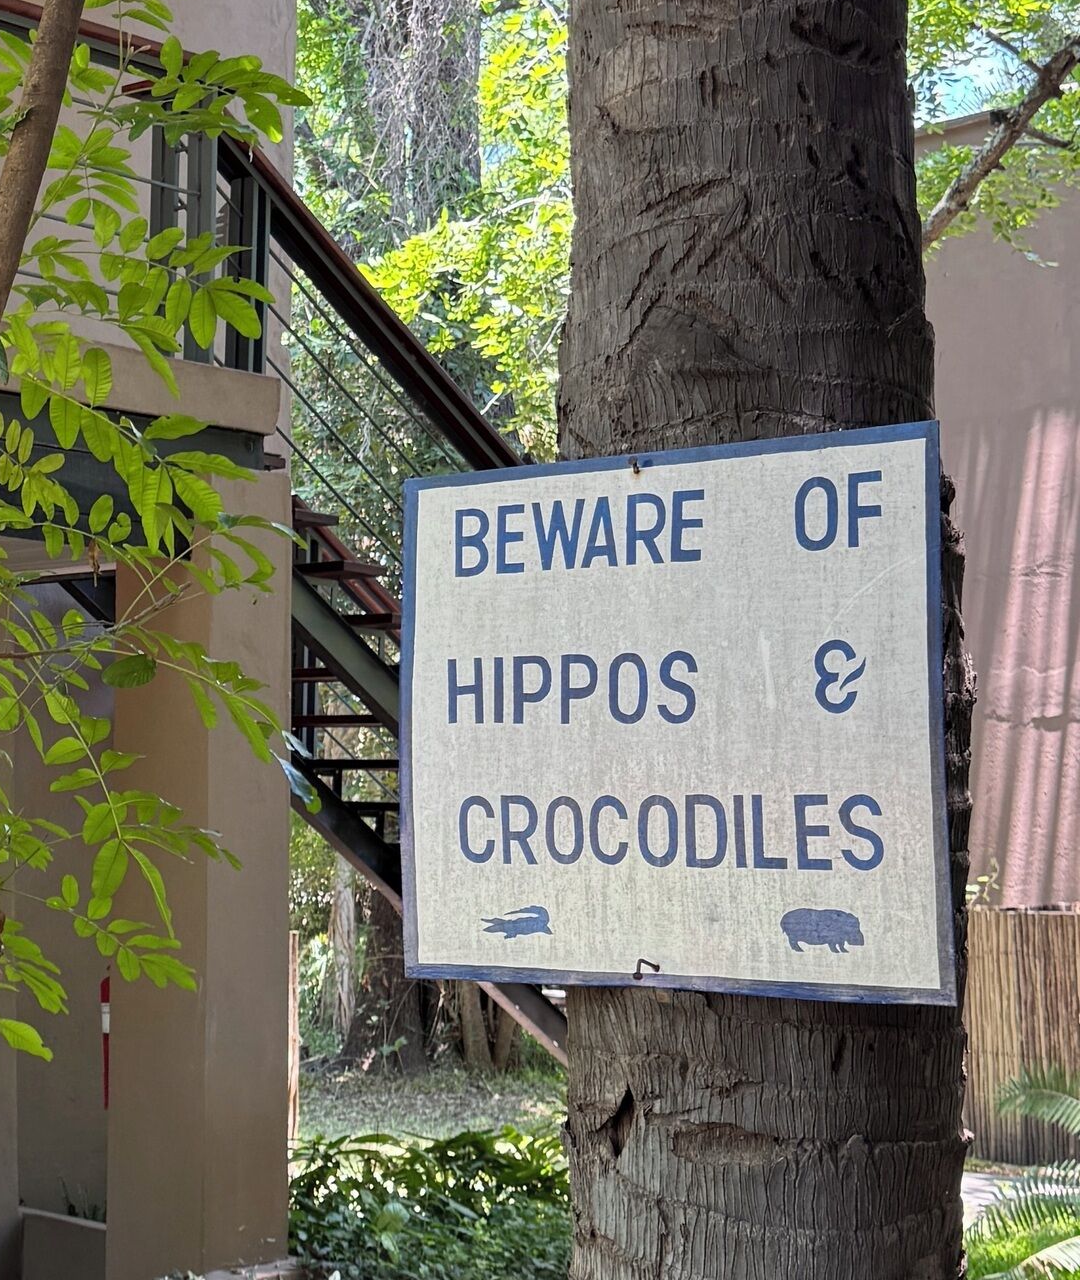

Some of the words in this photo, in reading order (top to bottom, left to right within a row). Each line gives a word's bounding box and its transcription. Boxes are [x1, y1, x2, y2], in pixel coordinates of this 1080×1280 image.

[453, 488, 705, 578] BEWARE
[794, 470, 883, 552] OF
[447, 650, 698, 724] HIPPOS
[814, 639, 866, 714] &
[458, 794, 885, 871] CROCODILES
